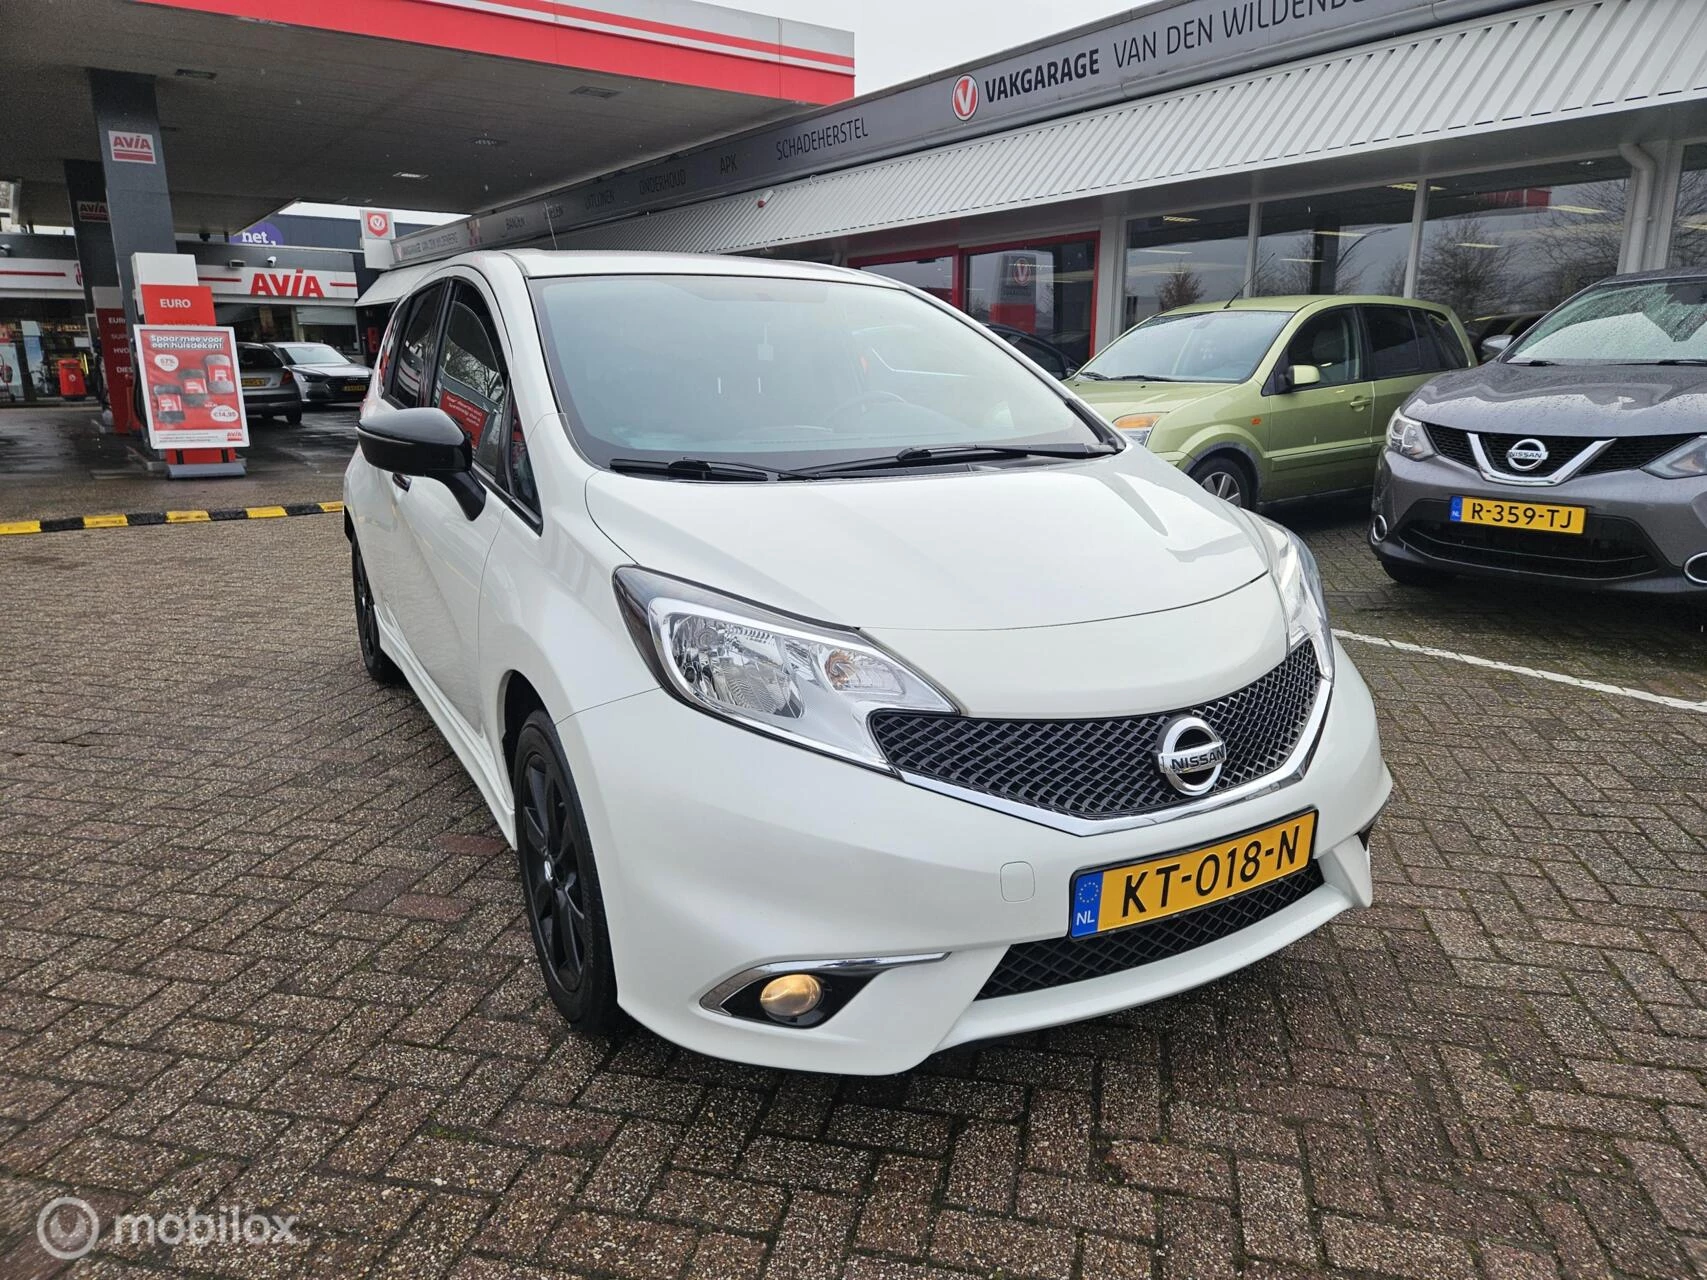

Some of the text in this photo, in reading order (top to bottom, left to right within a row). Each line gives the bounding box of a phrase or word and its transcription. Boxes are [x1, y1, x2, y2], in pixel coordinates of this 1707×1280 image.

[985, 48, 1100, 103] VAKGARAGE
[1113, 31, 1157, 69] VAN
[1167, 15, 1213, 55] DEN
[775, 117, 869, 161] SCHADEHERSTEL
[719, 152, 738, 176] APK
[639, 169, 687, 196] ONDERHOUD
[159, 298, 192, 309] EURO
[151, 334, 224, 344] Spaar mee voor
[171, 341, 224, 350] huisdeken!
[1509, 451, 1543, 459] NISSAN
[1471, 502, 1572, 529] R-359-TJ
[1170, 749, 1226, 772] NISSAN
[1121, 825, 1300, 919] KT-018-N
[1076, 911, 1095, 927] NL
